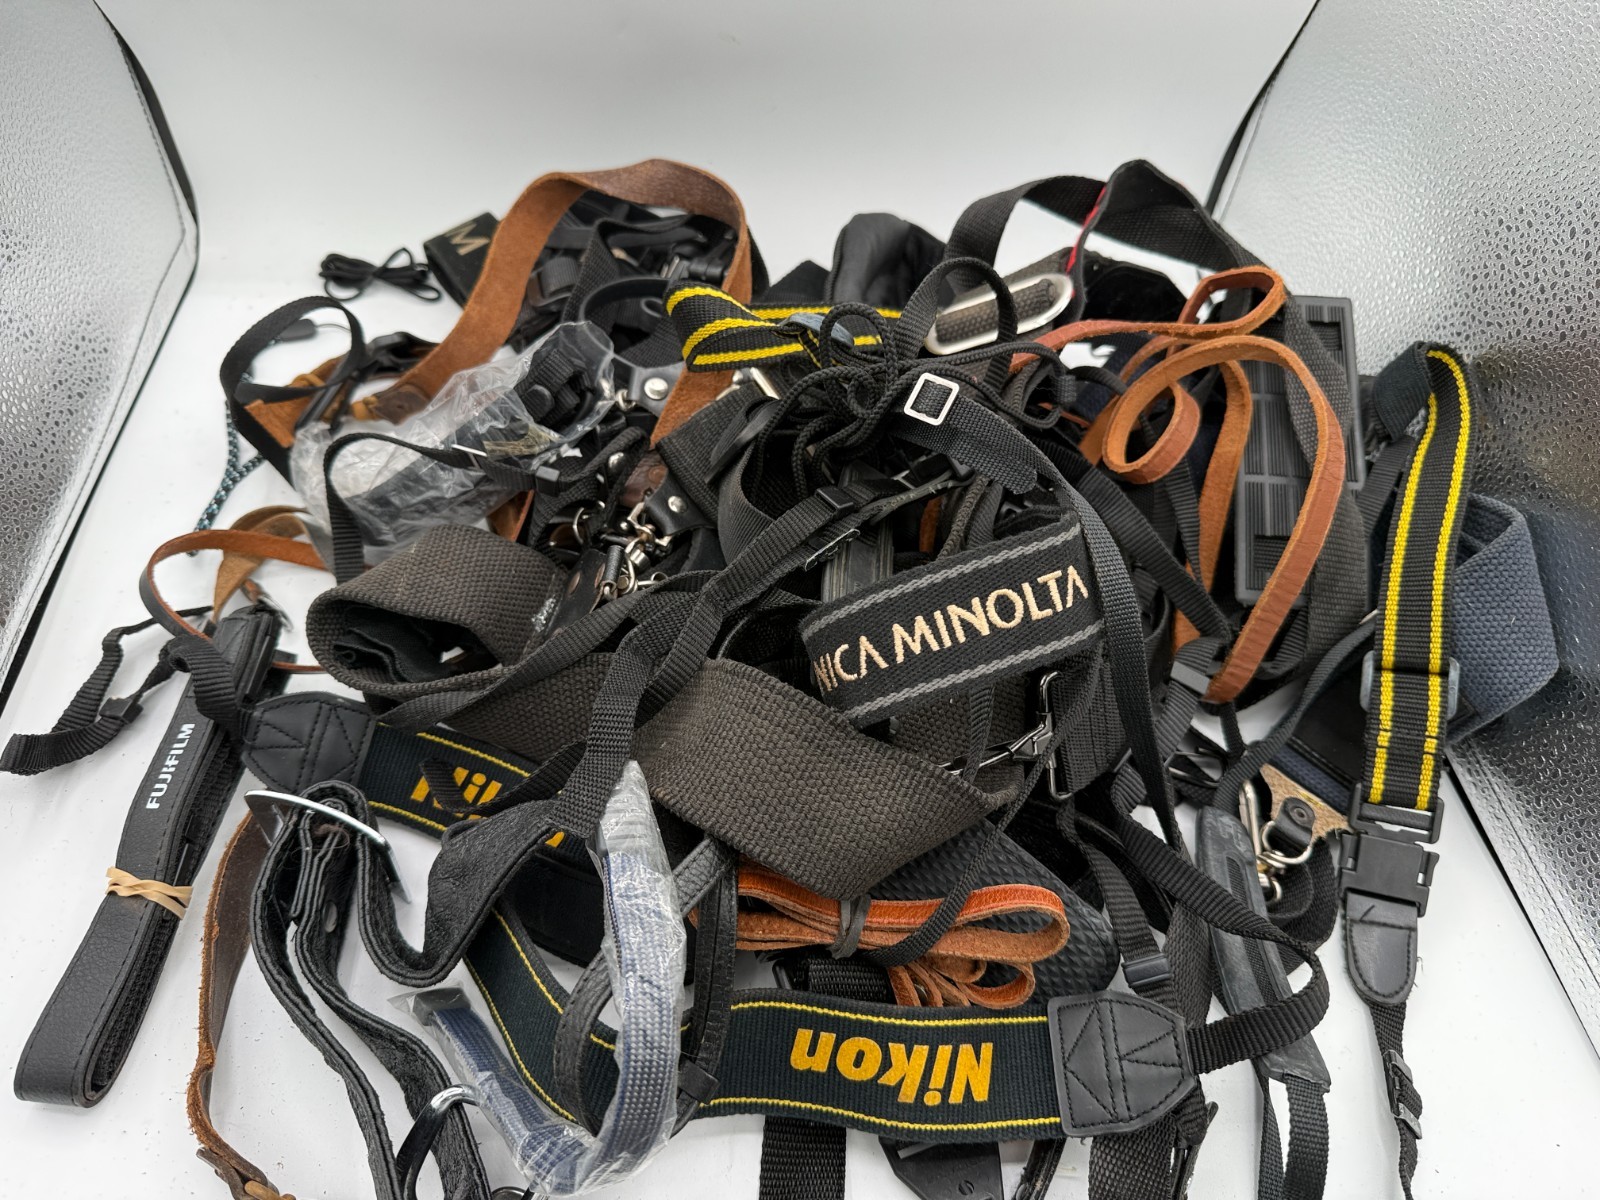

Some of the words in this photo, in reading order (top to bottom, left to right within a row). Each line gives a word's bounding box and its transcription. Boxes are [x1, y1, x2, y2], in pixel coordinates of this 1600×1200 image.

[892, 565, 1089, 664] MINOLTA
[145, 723, 196, 809] FUJIFILM
[789, 1028, 993, 1106] Nikon
